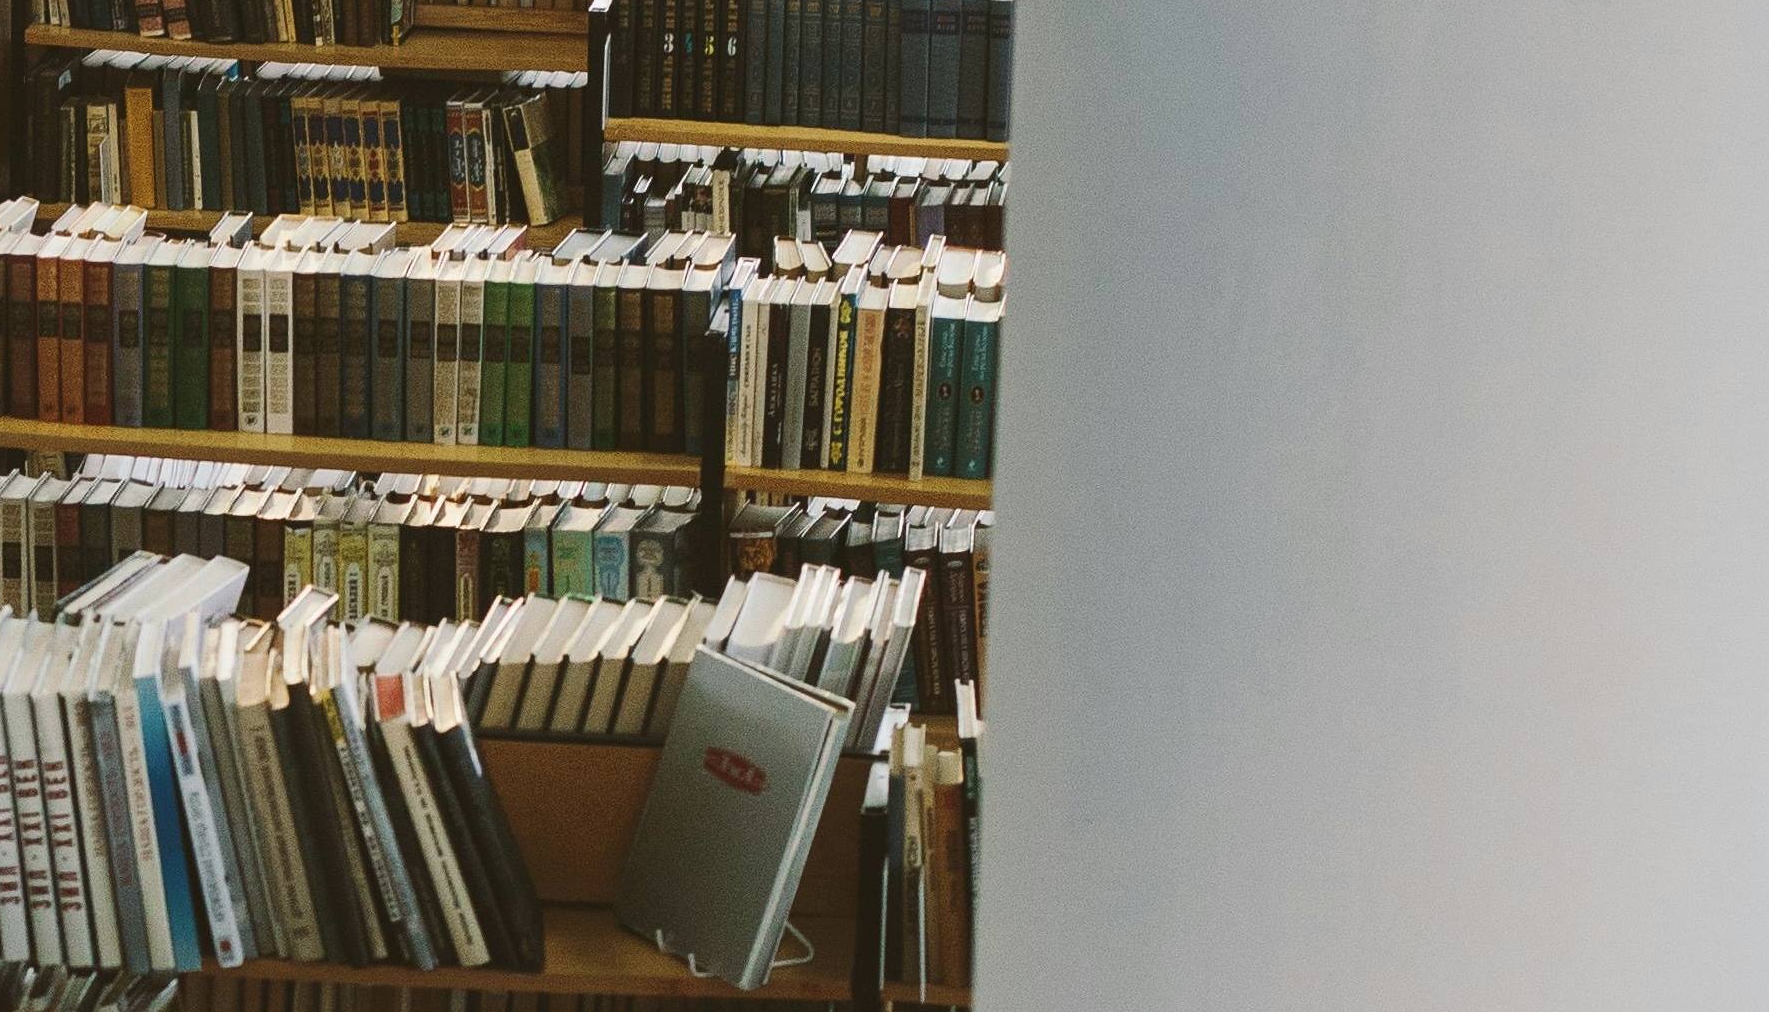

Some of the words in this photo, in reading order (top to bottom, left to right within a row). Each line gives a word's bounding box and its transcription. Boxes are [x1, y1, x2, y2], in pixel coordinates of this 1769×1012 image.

[664, 32, 674, 53] 3
[704, 35, 715, 56] 5
[727, 36, 737, 57] 6
[14, 759, 38, 798] ВЕК
[44, 761, 68, 800] ВЕК
[21, 812, 42, 846] XXI
[49, 813, 73, 847] XXI
